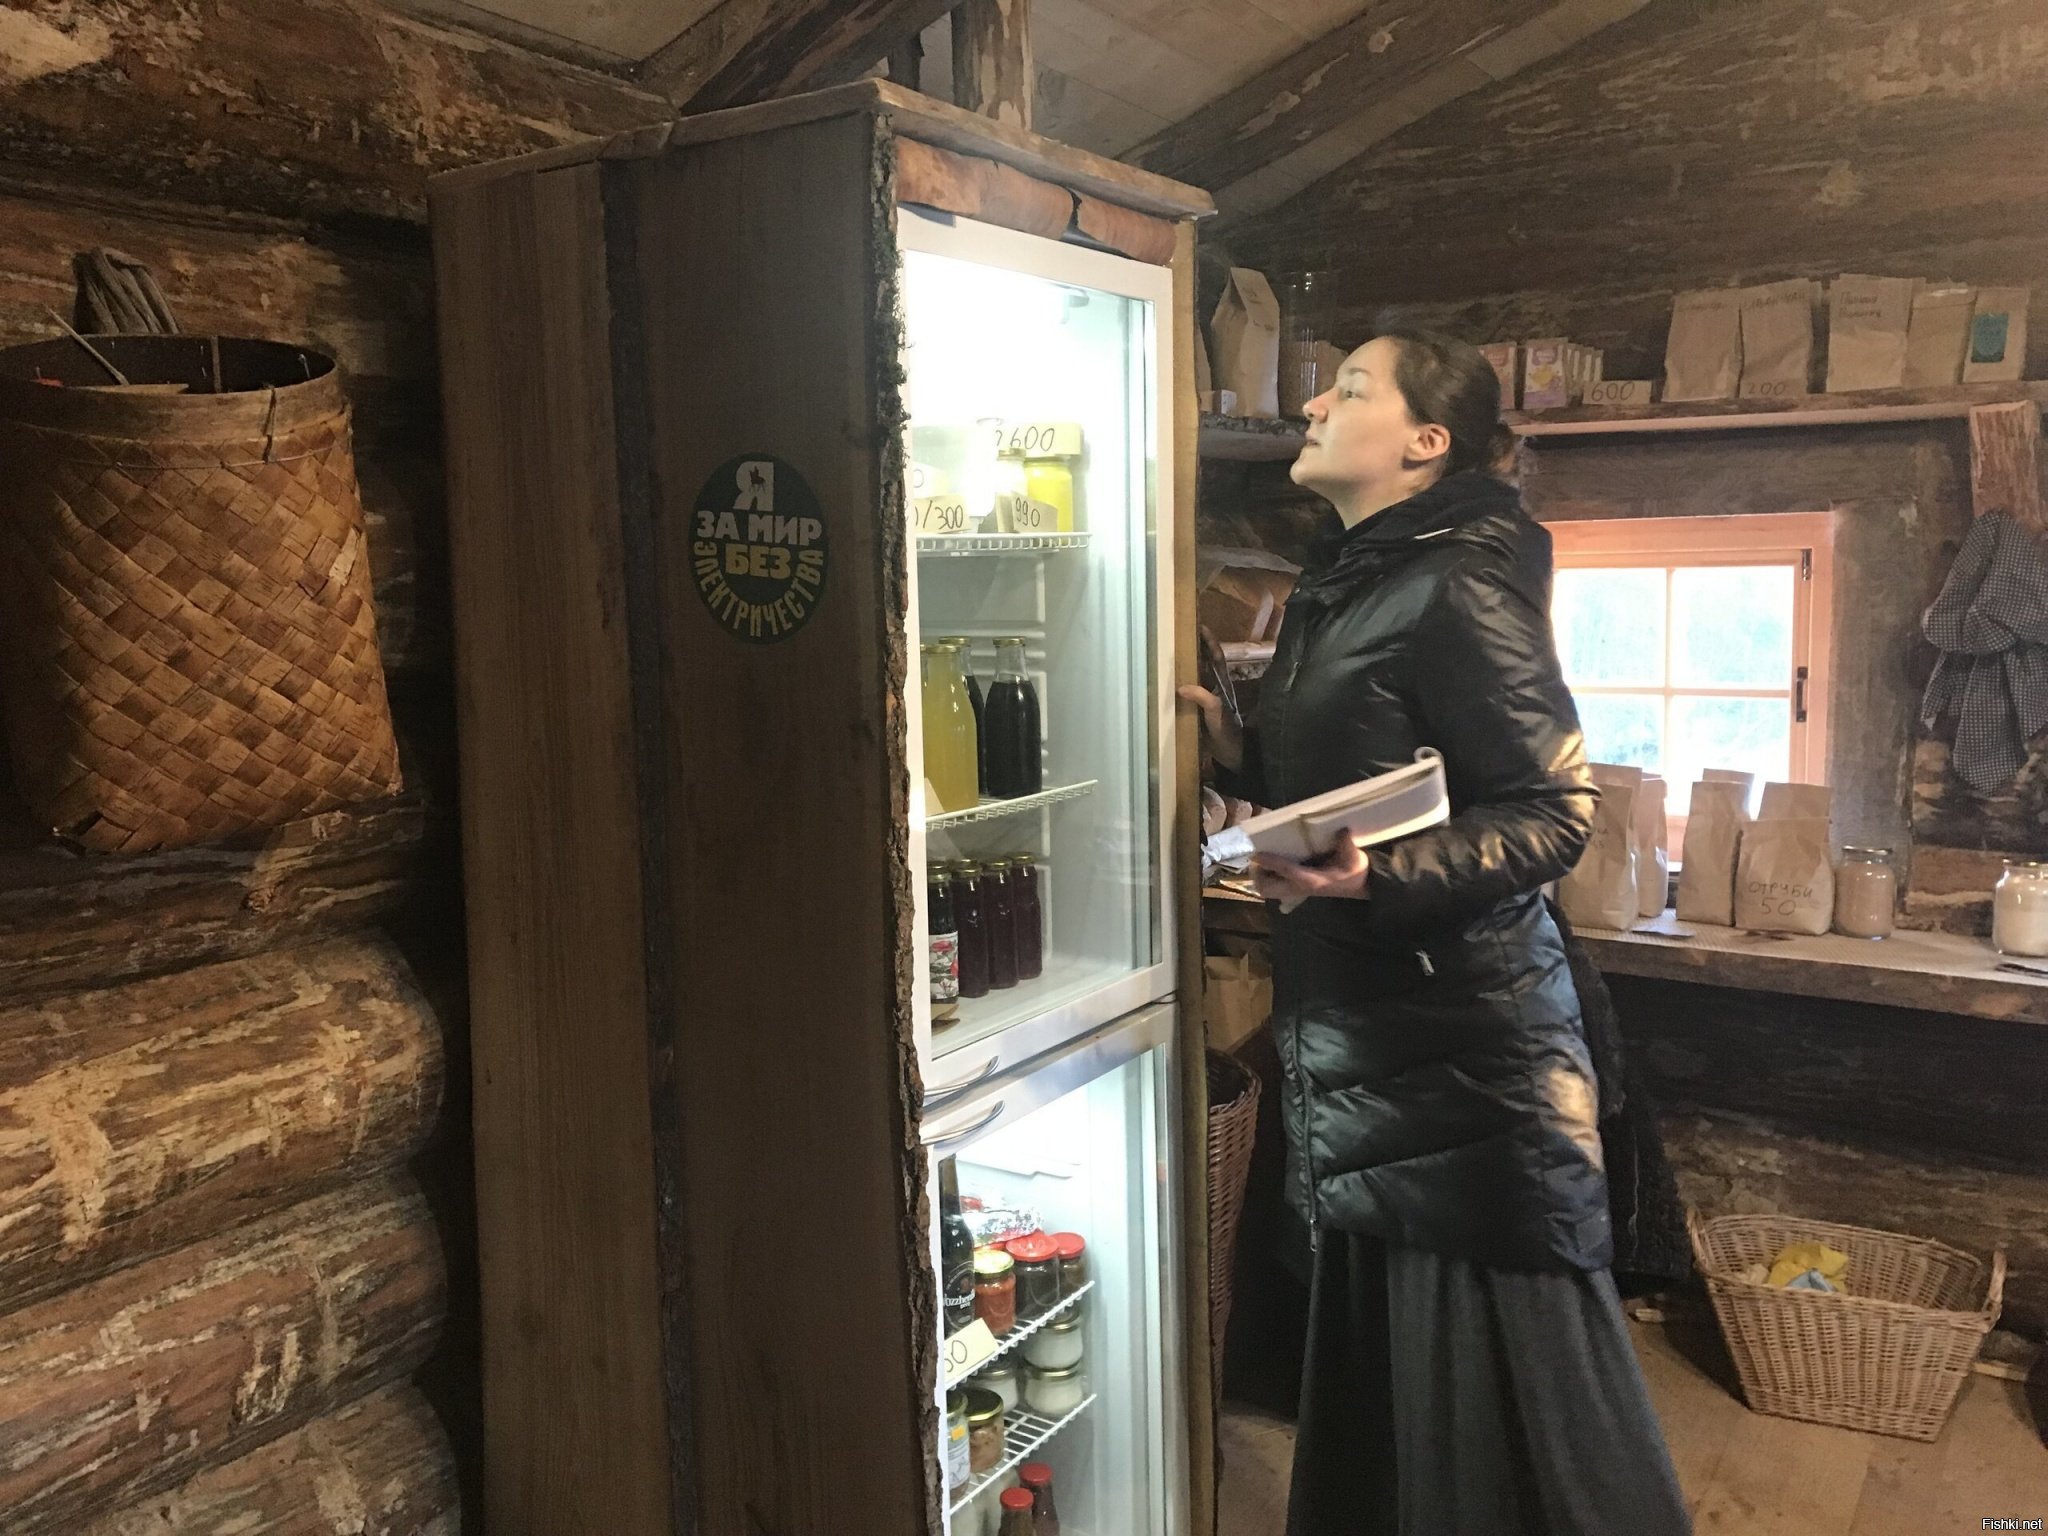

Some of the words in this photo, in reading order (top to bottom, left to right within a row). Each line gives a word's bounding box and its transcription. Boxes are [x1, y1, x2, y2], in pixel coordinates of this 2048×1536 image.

[1591, 382, 1636, 401] 600
[1747, 382, 1786, 396] 200
[733, 461, 774, 511] Я
[1015, 498, 1041, 528] 990
[697, 511, 740, 541] ЗА
[748, 513, 822, 546] МИР
[725, 544, 791, 580] БЕЗ
[693, 541, 824, 638] ЭЛЕКТРИЧЕСТВА
[1749, 881, 1813, 898] ОТРУБИ
[1761, 897, 1796, 916] 50
